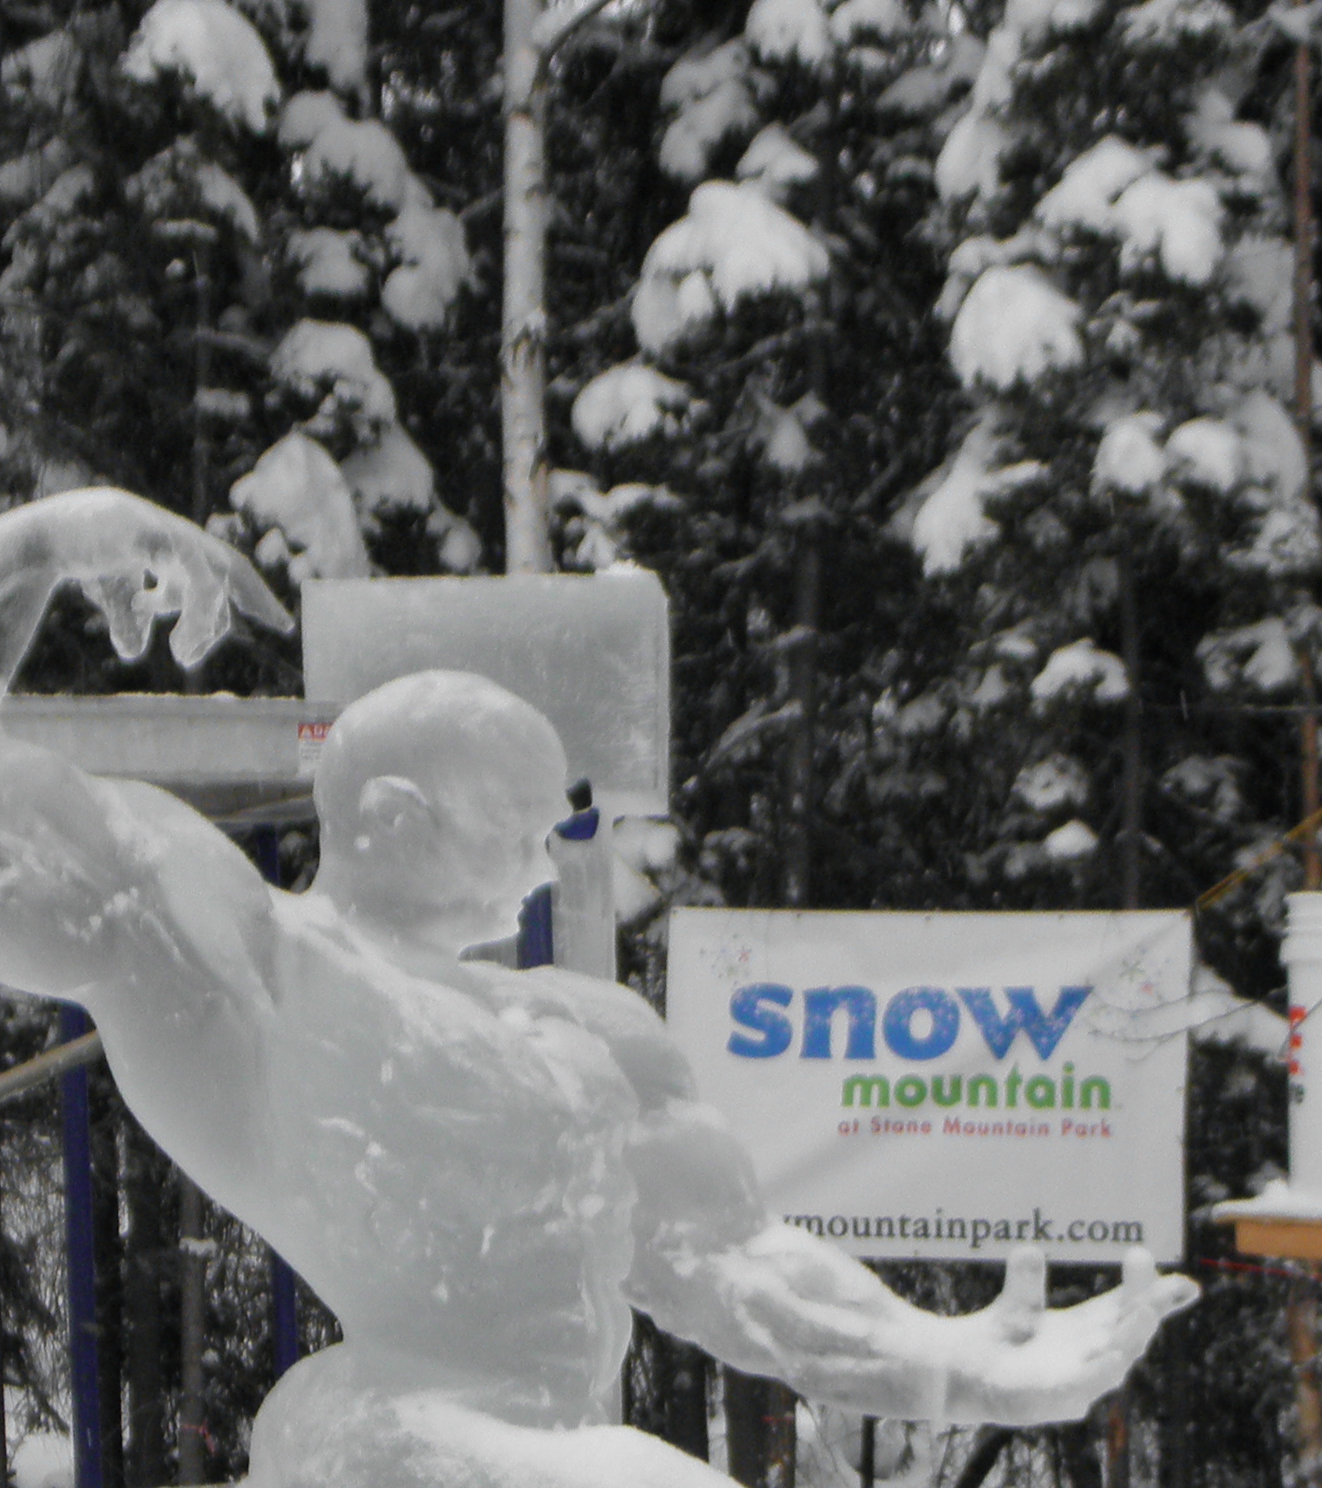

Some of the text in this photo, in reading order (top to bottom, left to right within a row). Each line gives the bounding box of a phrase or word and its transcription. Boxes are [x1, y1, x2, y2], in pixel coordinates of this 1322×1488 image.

[727, 983, 1093, 1060] snow
[842, 1063, 1111, 1109] mountain
[838, 1115, 1112, 1138] at Stone Mountain Park
[783, 1208, 1144, 1247] mountainpark.com
